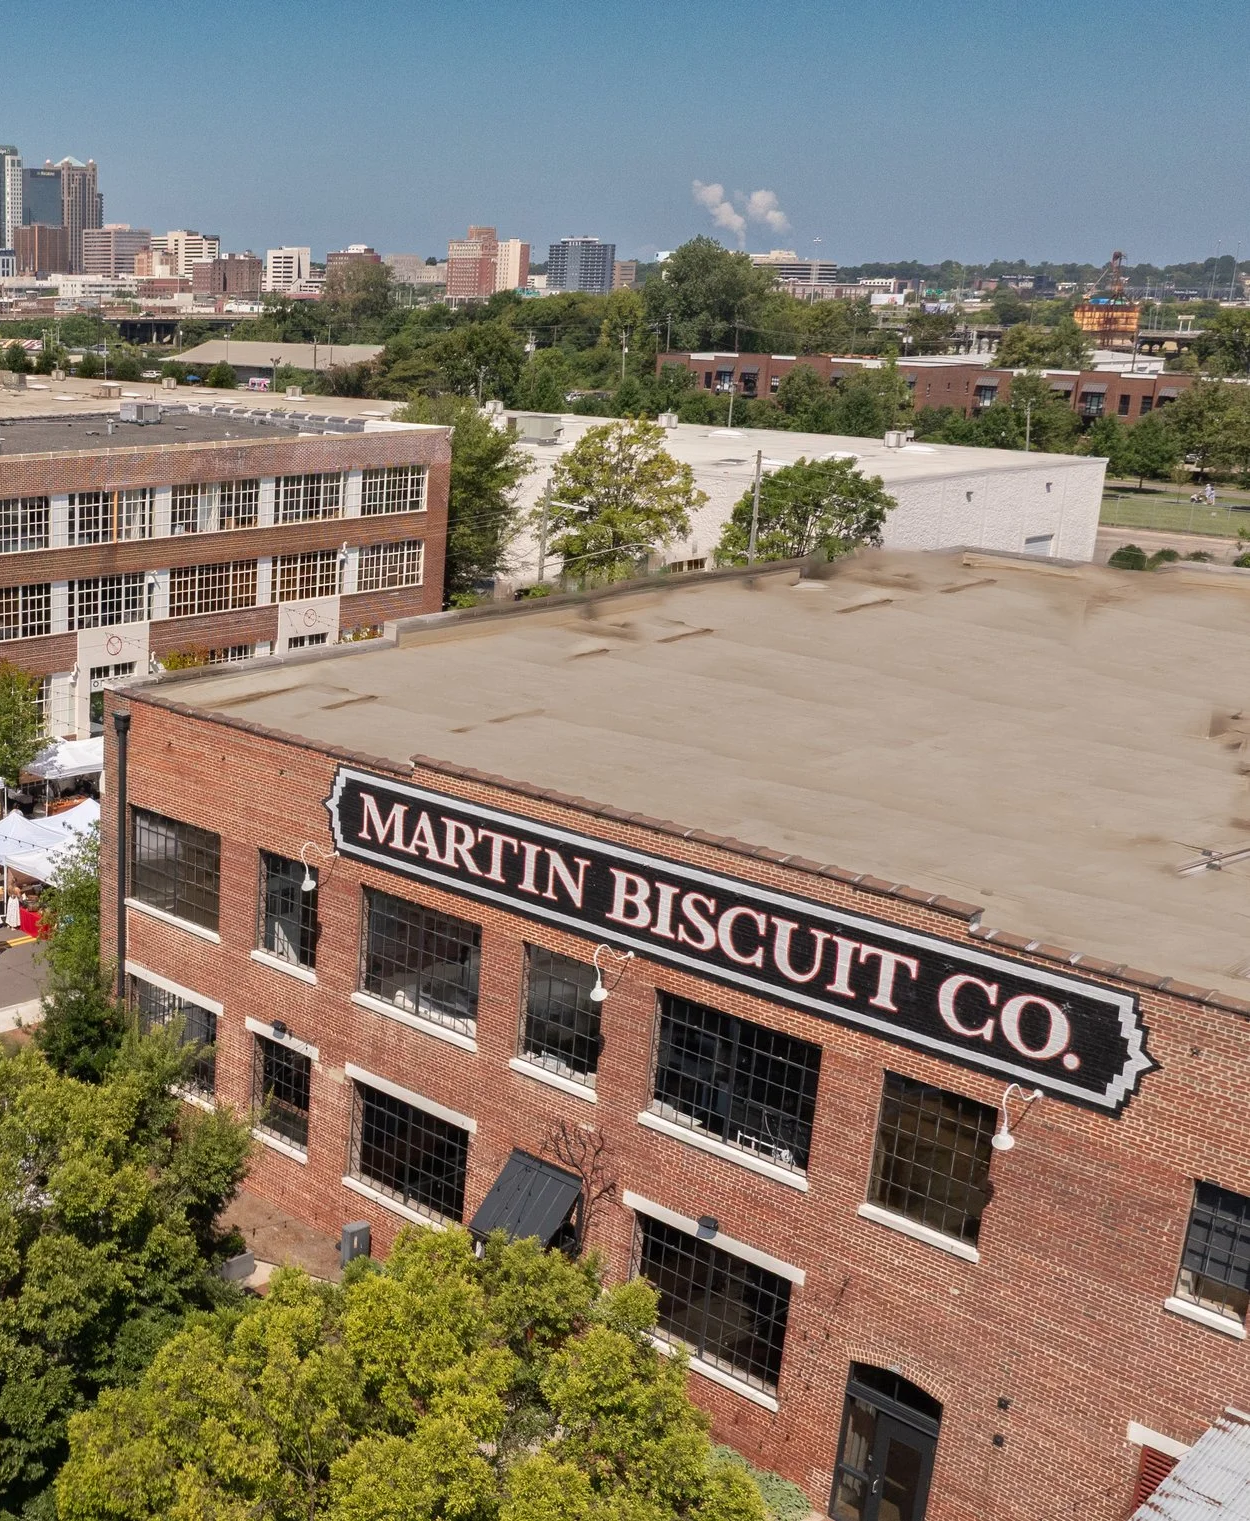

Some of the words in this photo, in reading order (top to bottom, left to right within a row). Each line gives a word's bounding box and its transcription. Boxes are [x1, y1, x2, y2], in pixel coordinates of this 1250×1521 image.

[357, 792, 591, 909] MARTIN
[605, 867, 920, 1013] BISCUIT
[938, 973, 1081, 1071] CO.
